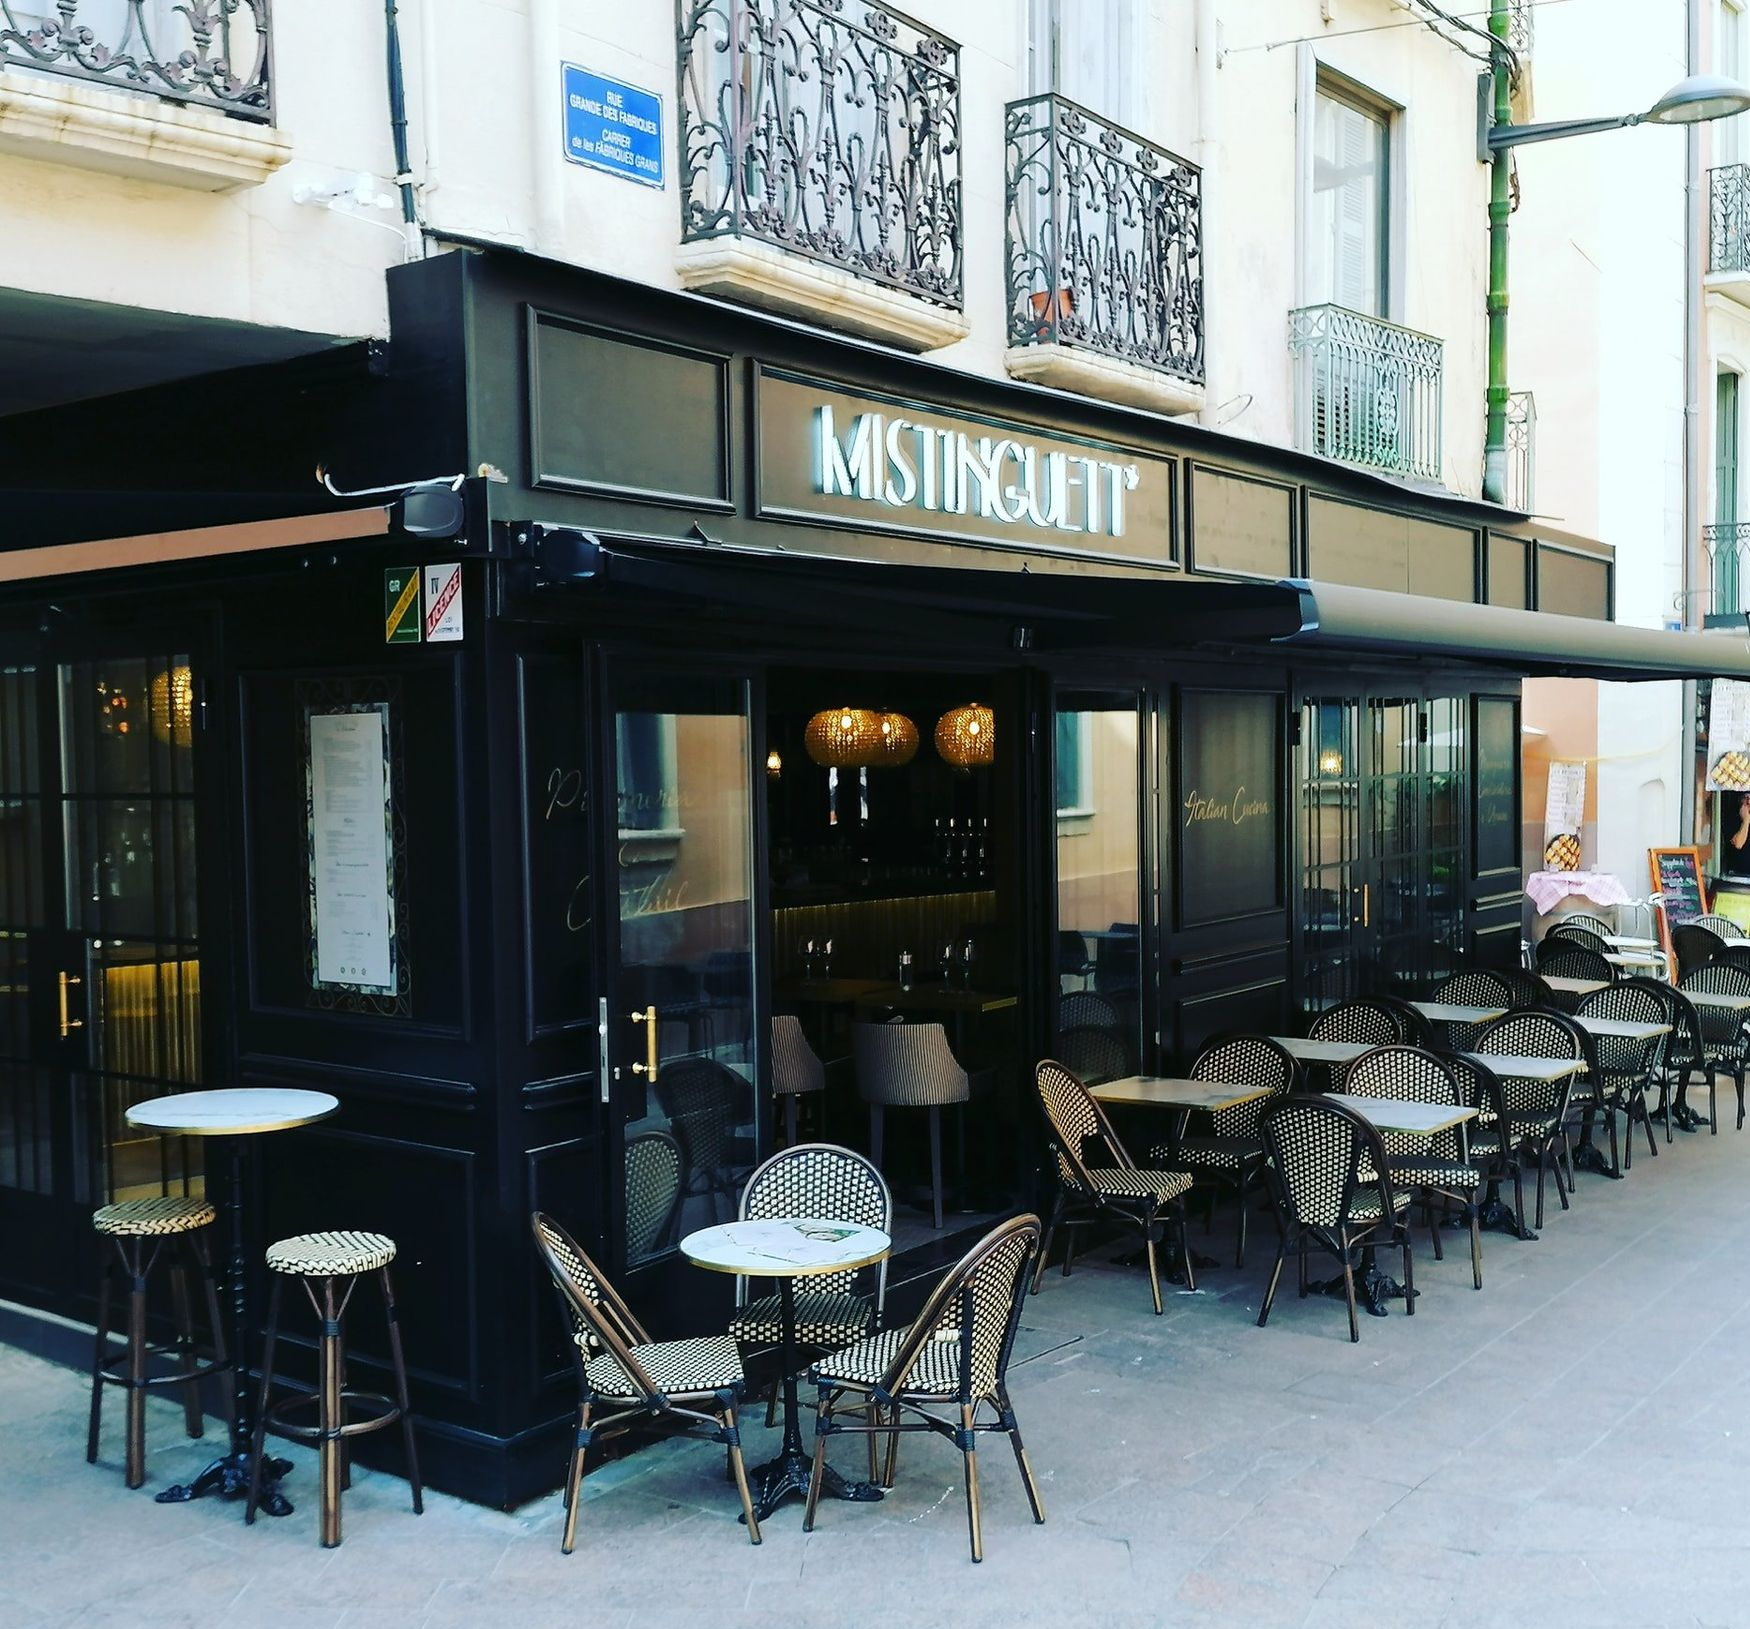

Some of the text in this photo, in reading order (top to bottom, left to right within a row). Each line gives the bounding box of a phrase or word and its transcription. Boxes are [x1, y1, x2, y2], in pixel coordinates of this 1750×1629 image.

[569, 92, 657, 135] GRANDE DES FABRIQUES
[606, 91, 623, 108] RUE
[571, 136, 582, 149] de
[634, 153, 659, 174] GRANS
[601, 128, 631, 149] CARRER
[389, 580, 400, 592] GR
[427, 569, 460, 635] LICENCE
[1184, 790, 1227, 828] Italian
